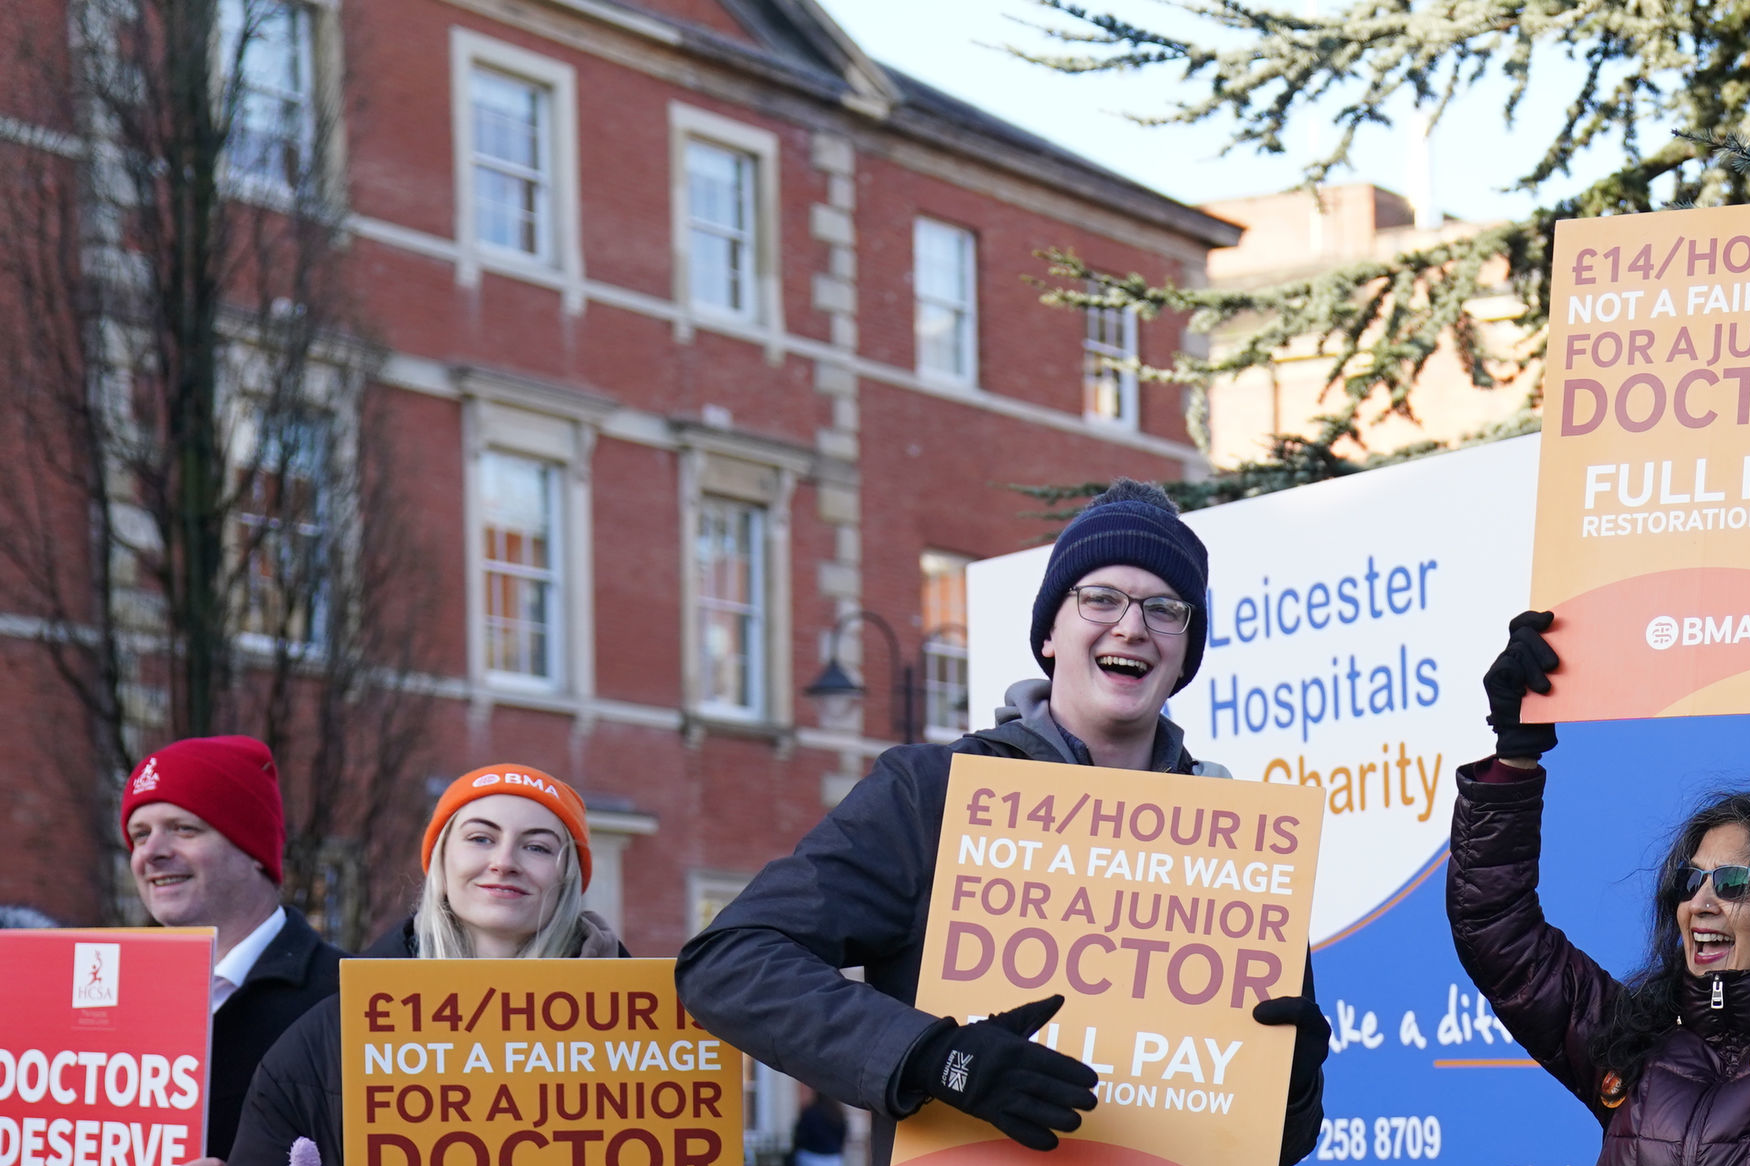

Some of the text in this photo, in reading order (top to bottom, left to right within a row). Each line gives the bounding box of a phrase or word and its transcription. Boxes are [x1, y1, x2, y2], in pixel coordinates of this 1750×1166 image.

[1568, 290, 1644, 325] NOT
[1650, 288, 1677, 319] A
[1565, 329, 1656, 370] FOR
[1665, 326, 1699, 363] A
[1584, 458, 1726, 510] FULL
[1207, 554, 1438, 649] Leicester
[1210, 643, 1440, 743] Hospitals
[505, 773, 559, 799] BMA
[966, 787, 1301, 855] £14/HOUR IS
[958, 834, 1295, 896] NOT A FAIR WAGE
[951, 874, 1291, 943] FOR A JUNIOR
[941, 920, 1283, 1009] DOCTOR
[365, 987, 658, 1032] £14/HOUR
[1399, 1010, 1427, 1050] a
[365, 1040, 722, 1074] NOT A FAIR WAGE
[1130, 1031, 1244, 1085] PAY
[366, 1081, 723, 1129] FOR A JUNIOR
[1164, 1087, 1235, 1115] NOW
[1317, 1115, 1442, 1161] 258 8709
